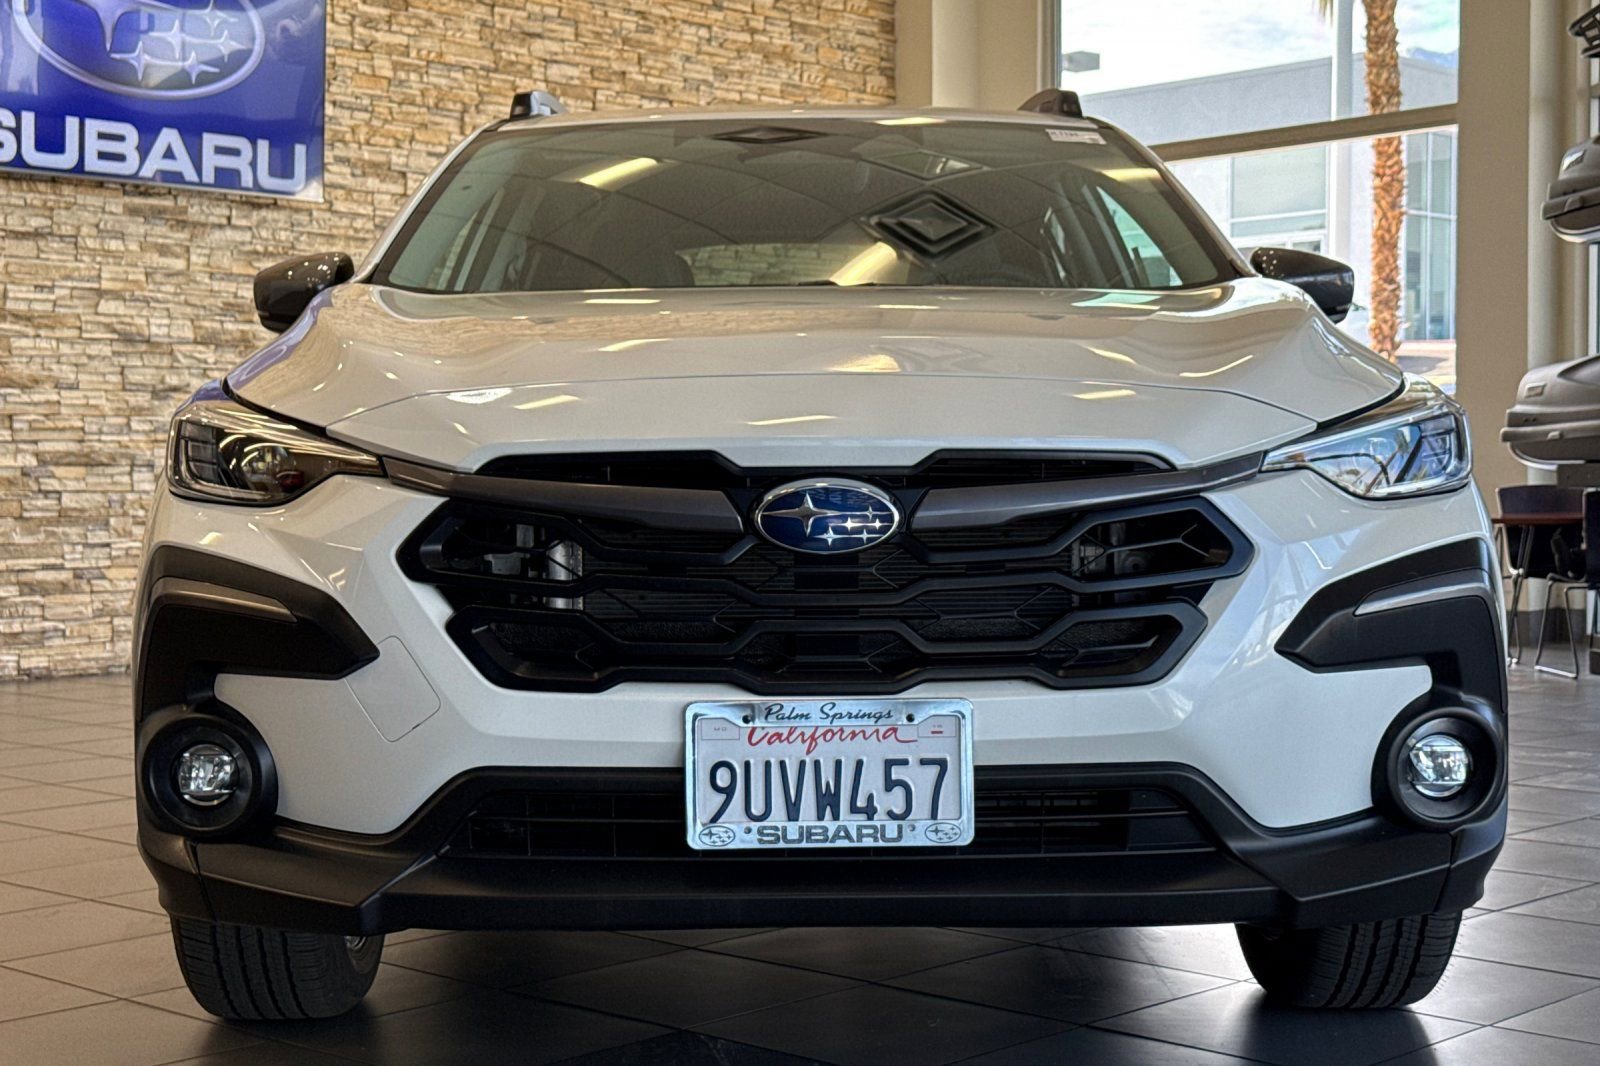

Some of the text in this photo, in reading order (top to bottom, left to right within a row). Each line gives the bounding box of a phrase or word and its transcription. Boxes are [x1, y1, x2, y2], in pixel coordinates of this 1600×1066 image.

[764, 701, 893, 725] Palm Springs
[747, 726, 918, 756] California
[709, 758, 949, 824] 9UVW457
[756, 824, 903, 845] SUBARU
